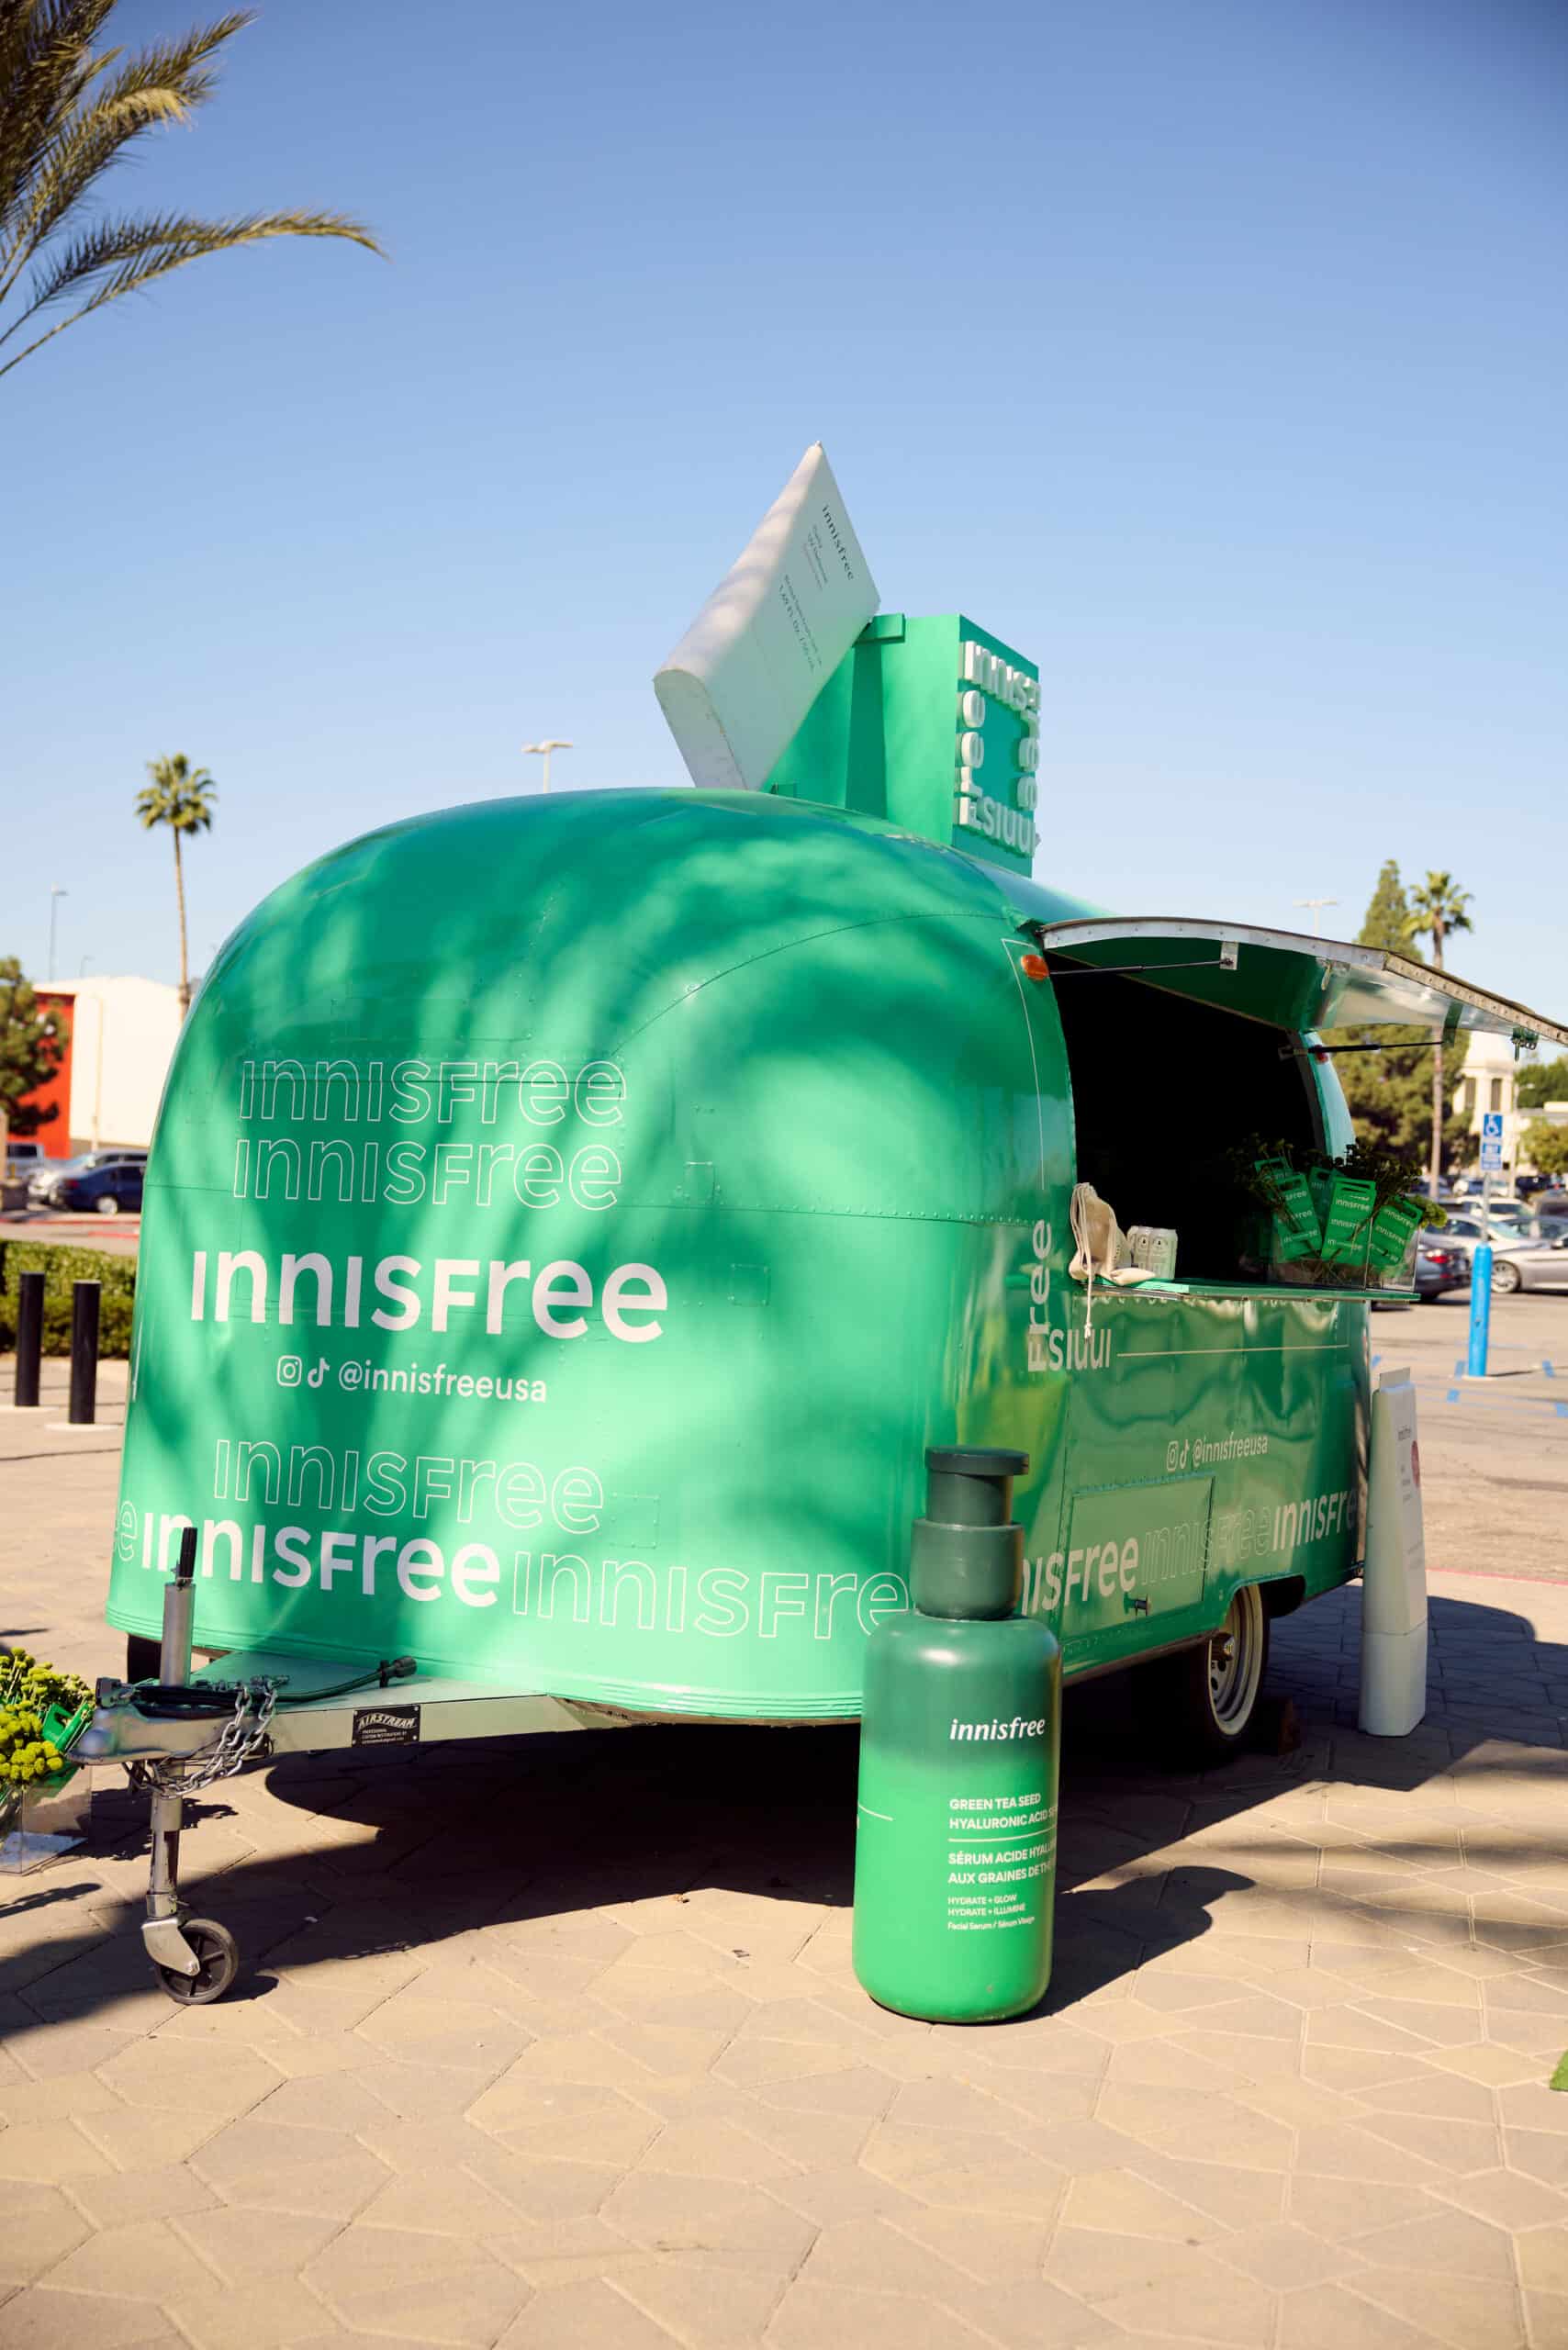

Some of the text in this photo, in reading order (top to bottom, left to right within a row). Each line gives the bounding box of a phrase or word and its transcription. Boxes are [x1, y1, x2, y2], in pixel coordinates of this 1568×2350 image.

[338, 1359, 548, 1404] @innisfreeusa
[1193, 1431, 1269, 1467] @innisfreeusa
[358, 1713, 415, 1729] AIRSTREAM
[949, 1716, 1046, 1740] innisfree
[948, 1793, 1041, 1811] GREEN TEA SEED
[948, 1814, 1028, 1830] HYALURONIC
[1028, 1808, 1048, 1824] ACID
[948, 1850, 993, 1865] SÉRUM
[994, 1848, 1029, 1863] ACIDE
[948, 1872, 975, 1885] AUX
[978, 1866, 1027, 1884] GRAINES
[1028, 1864, 1040, 1877] DE
[948, 1894, 1017, 1905] HYDRATE GLOW
[948, 1908, 986, 1916] HYDRATE
